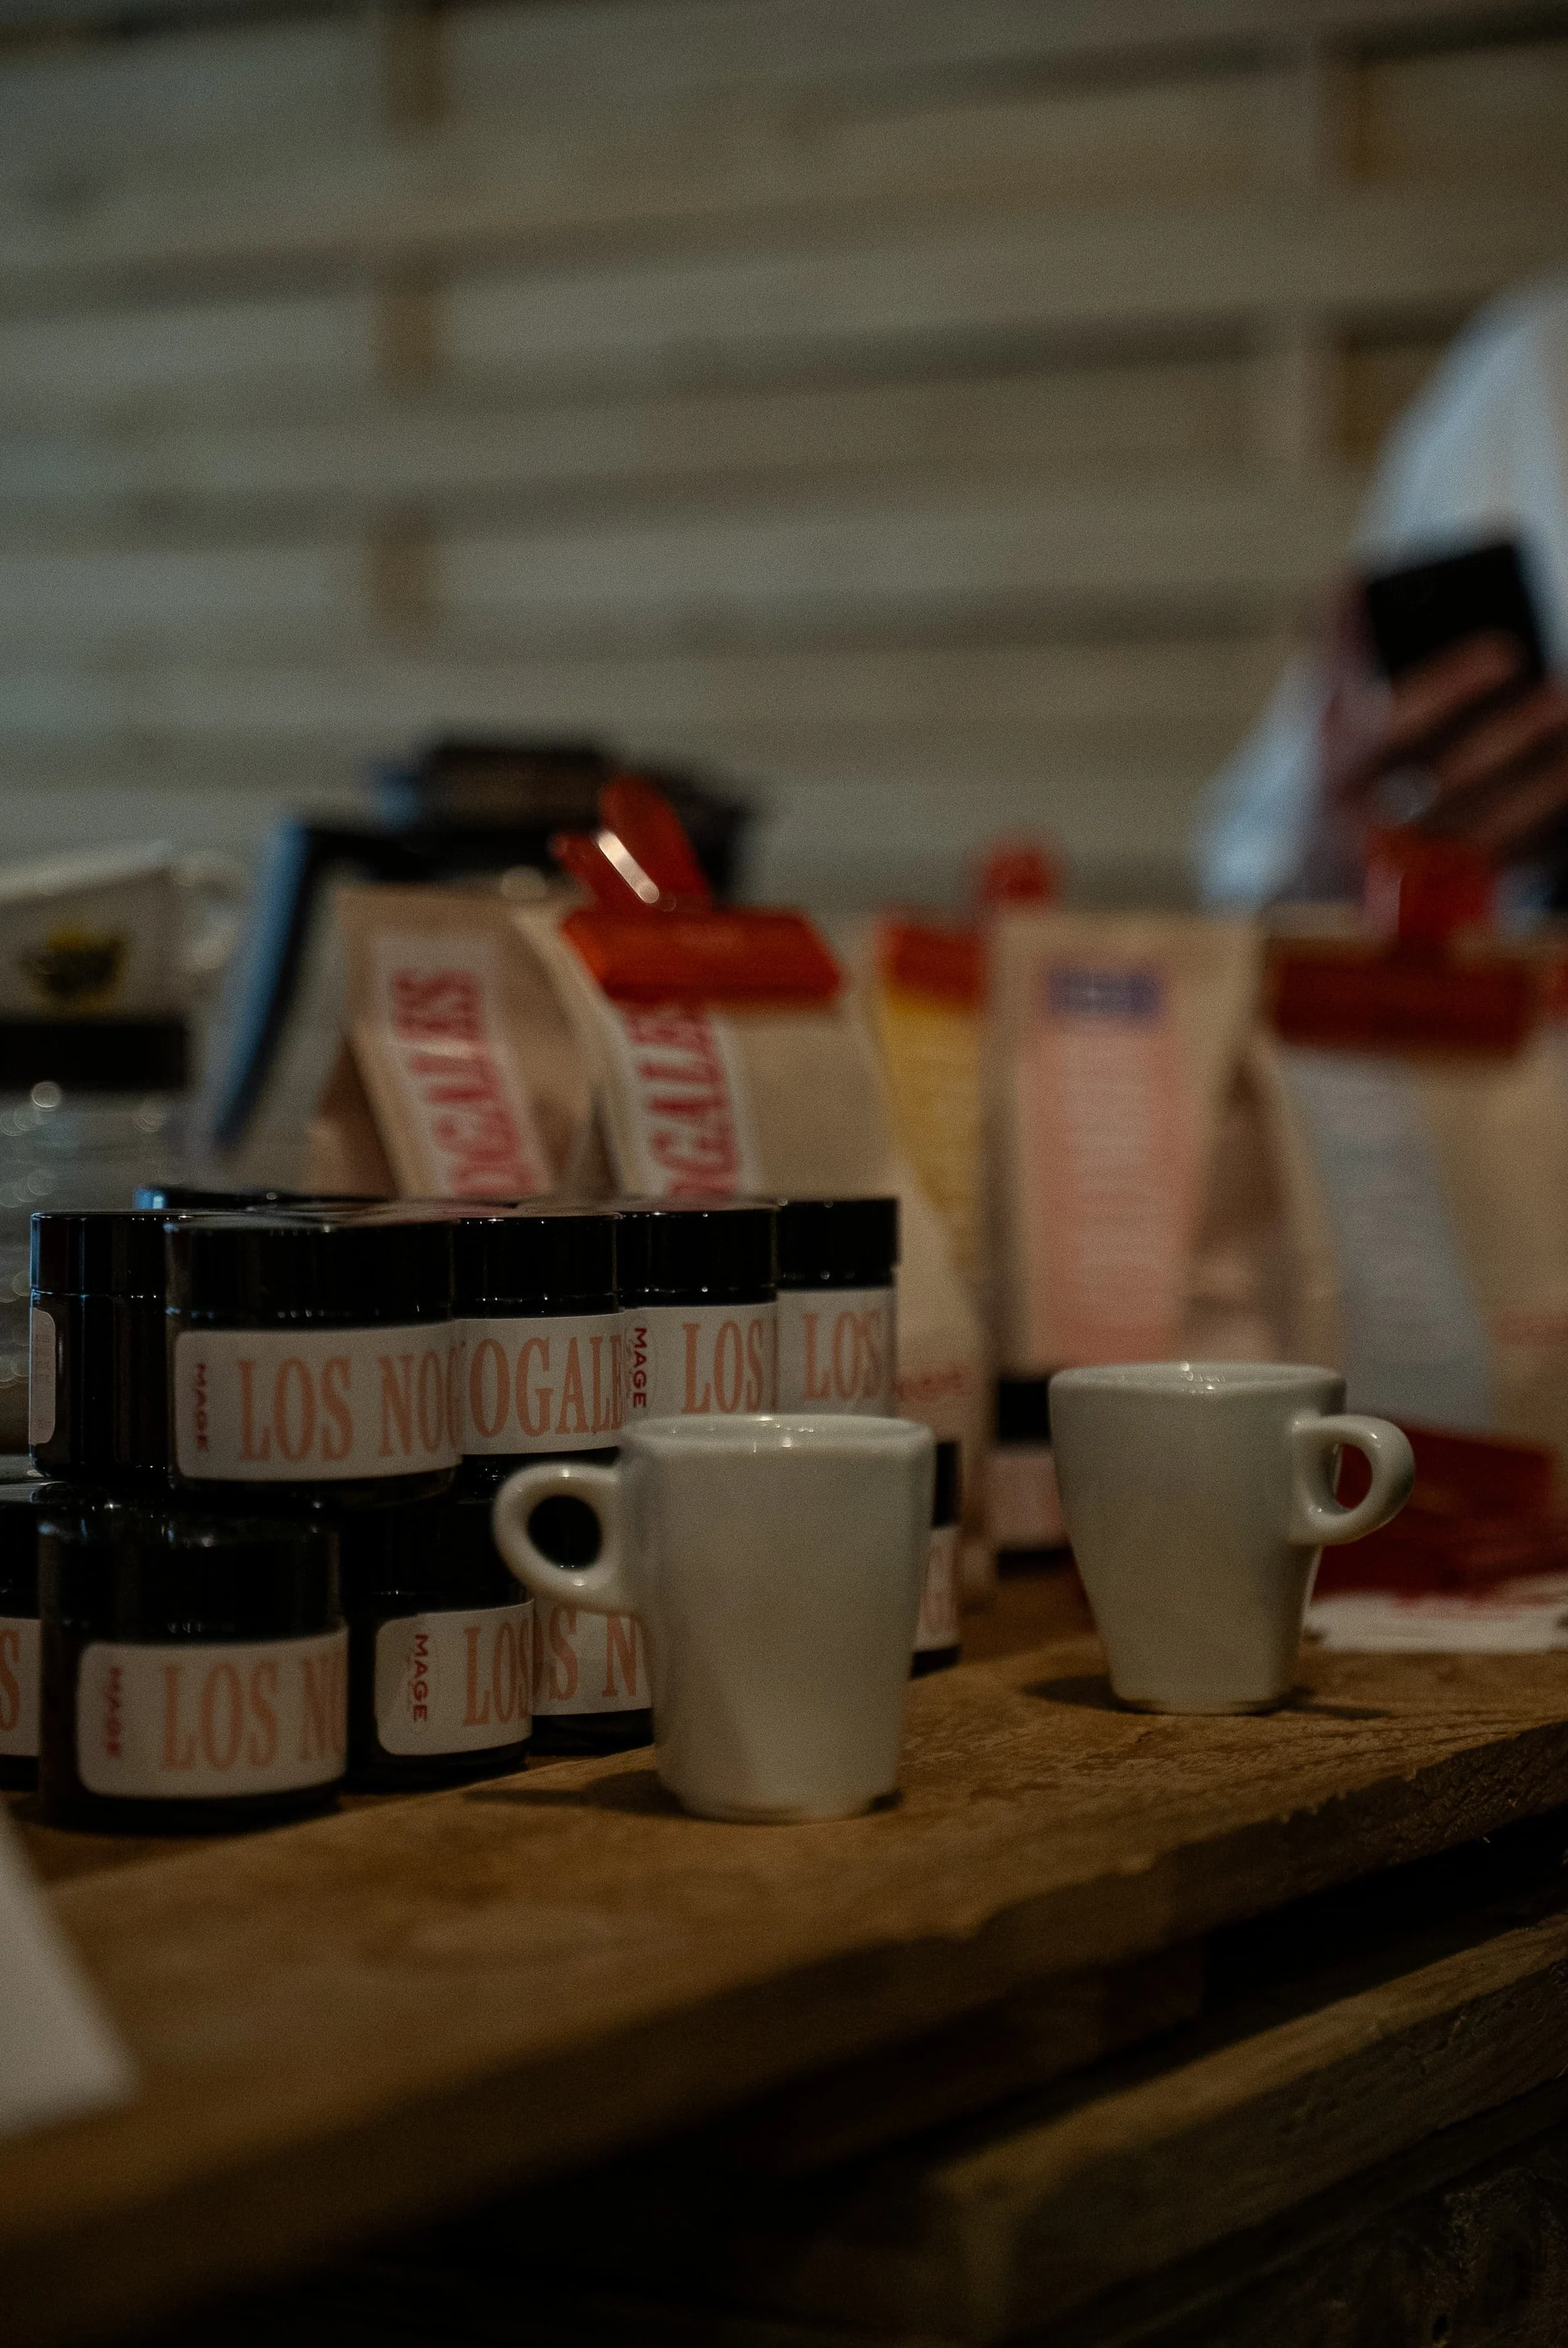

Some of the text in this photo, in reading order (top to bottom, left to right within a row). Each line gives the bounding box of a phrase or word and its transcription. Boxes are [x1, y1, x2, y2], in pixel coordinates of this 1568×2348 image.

[237, 1356, 353, 1462] LOS
[633, 1327, 647, 1408] MAGE
[682, 1319, 763, 1413] LOS
[105, 1666, 123, 1757] MAGE
[162, 1660, 278, 1771] LOS
[412, 1634, 428, 1722] MAGE
